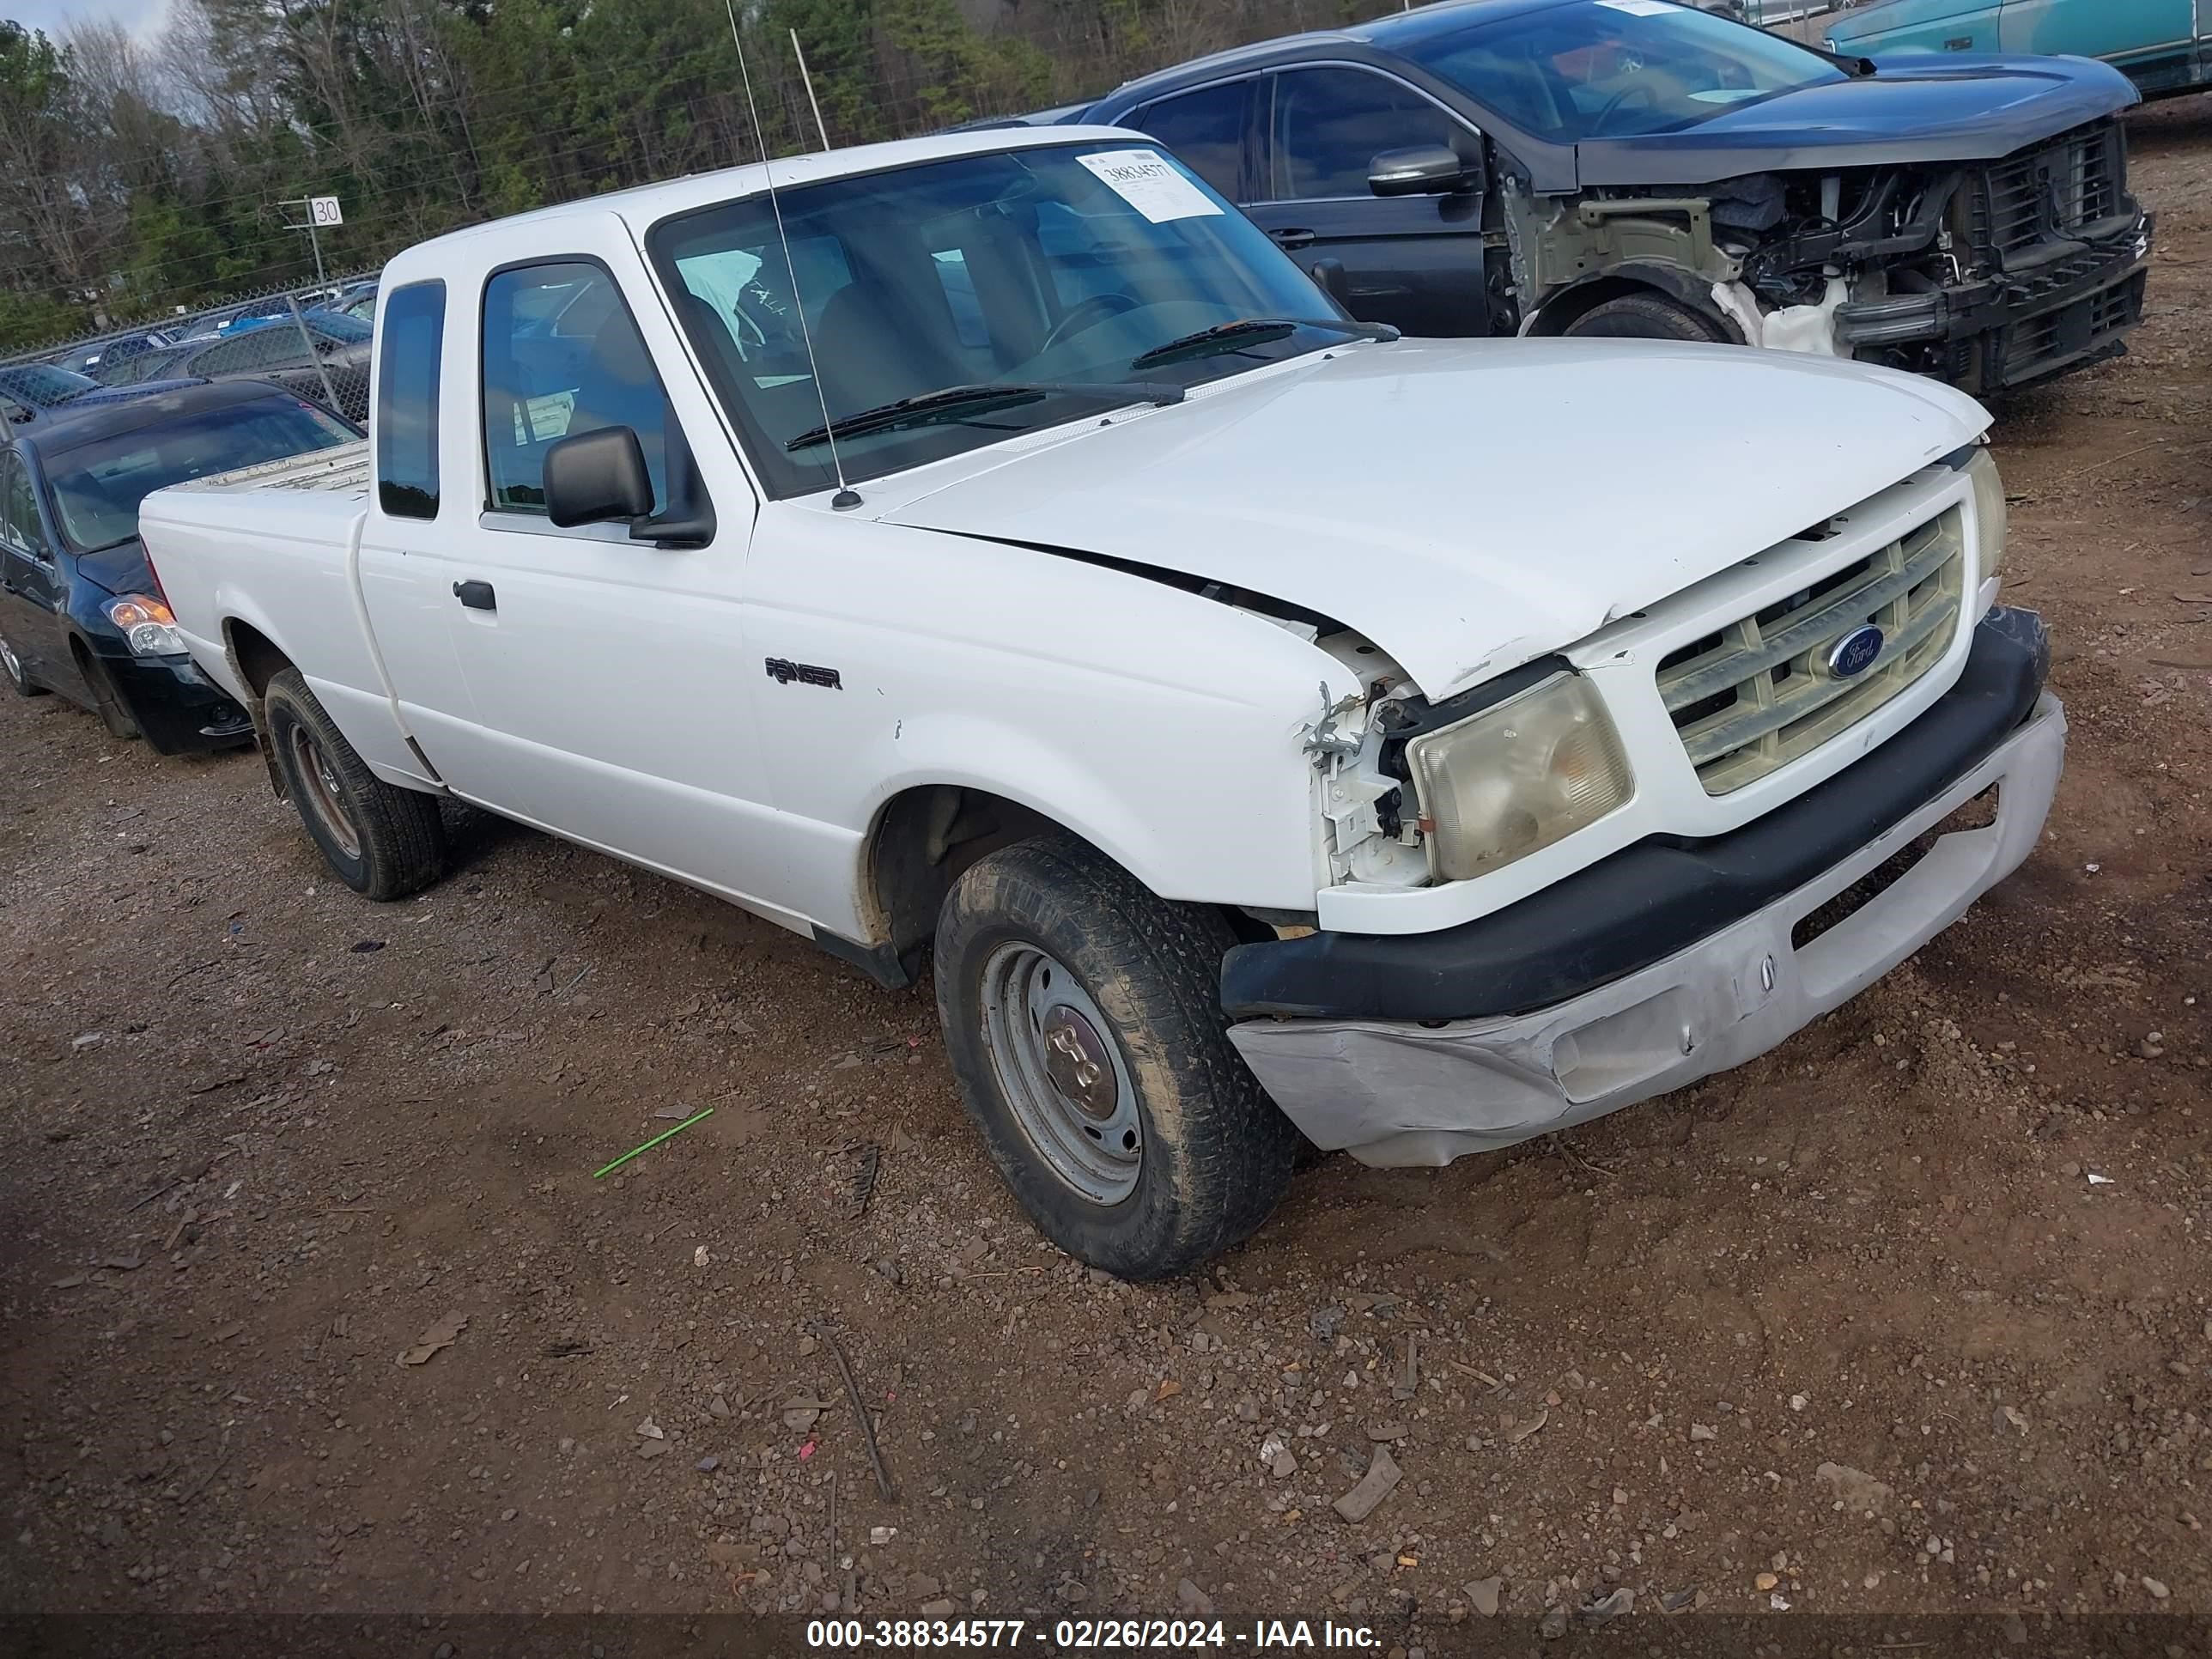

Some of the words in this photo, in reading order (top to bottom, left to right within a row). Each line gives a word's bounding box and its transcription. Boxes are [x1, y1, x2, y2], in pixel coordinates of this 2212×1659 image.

[1103, 164, 1171, 183] 38834577
[315, 200, 338, 222] 30
[1846, 638, 1875, 668] Ford
